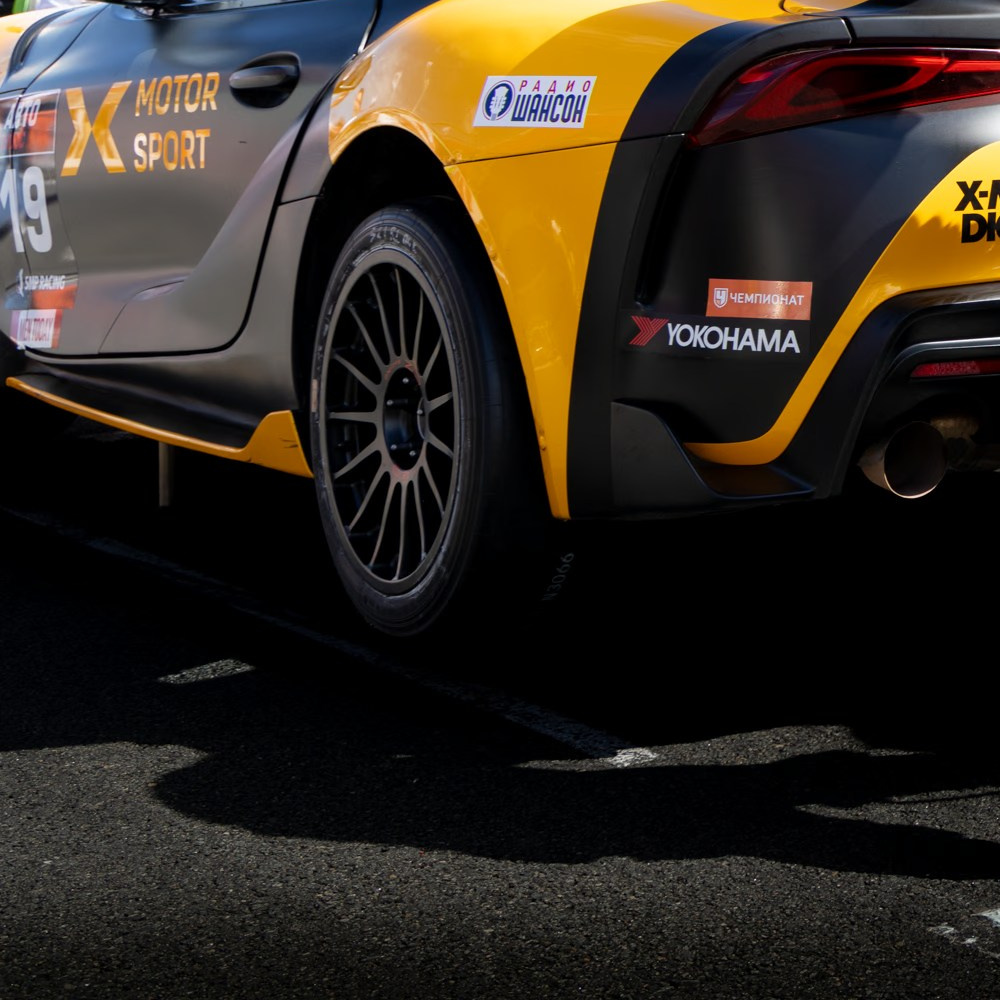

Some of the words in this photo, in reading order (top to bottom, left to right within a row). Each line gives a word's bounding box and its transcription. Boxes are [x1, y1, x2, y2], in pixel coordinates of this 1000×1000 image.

[135, 72, 220, 117] MOTOR
[519, 80, 591, 94] РАДИО
[511, 93, 587, 123] ШАНСОН
[60, 80, 132, 177] X
[133, 129, 211, 173] SPORT
[0, 165, 53, 253] 19
[730, 292, 804, 306] ЧЕМПИОНАТ
[666, 323, 801, 354] YOKOHAMA
